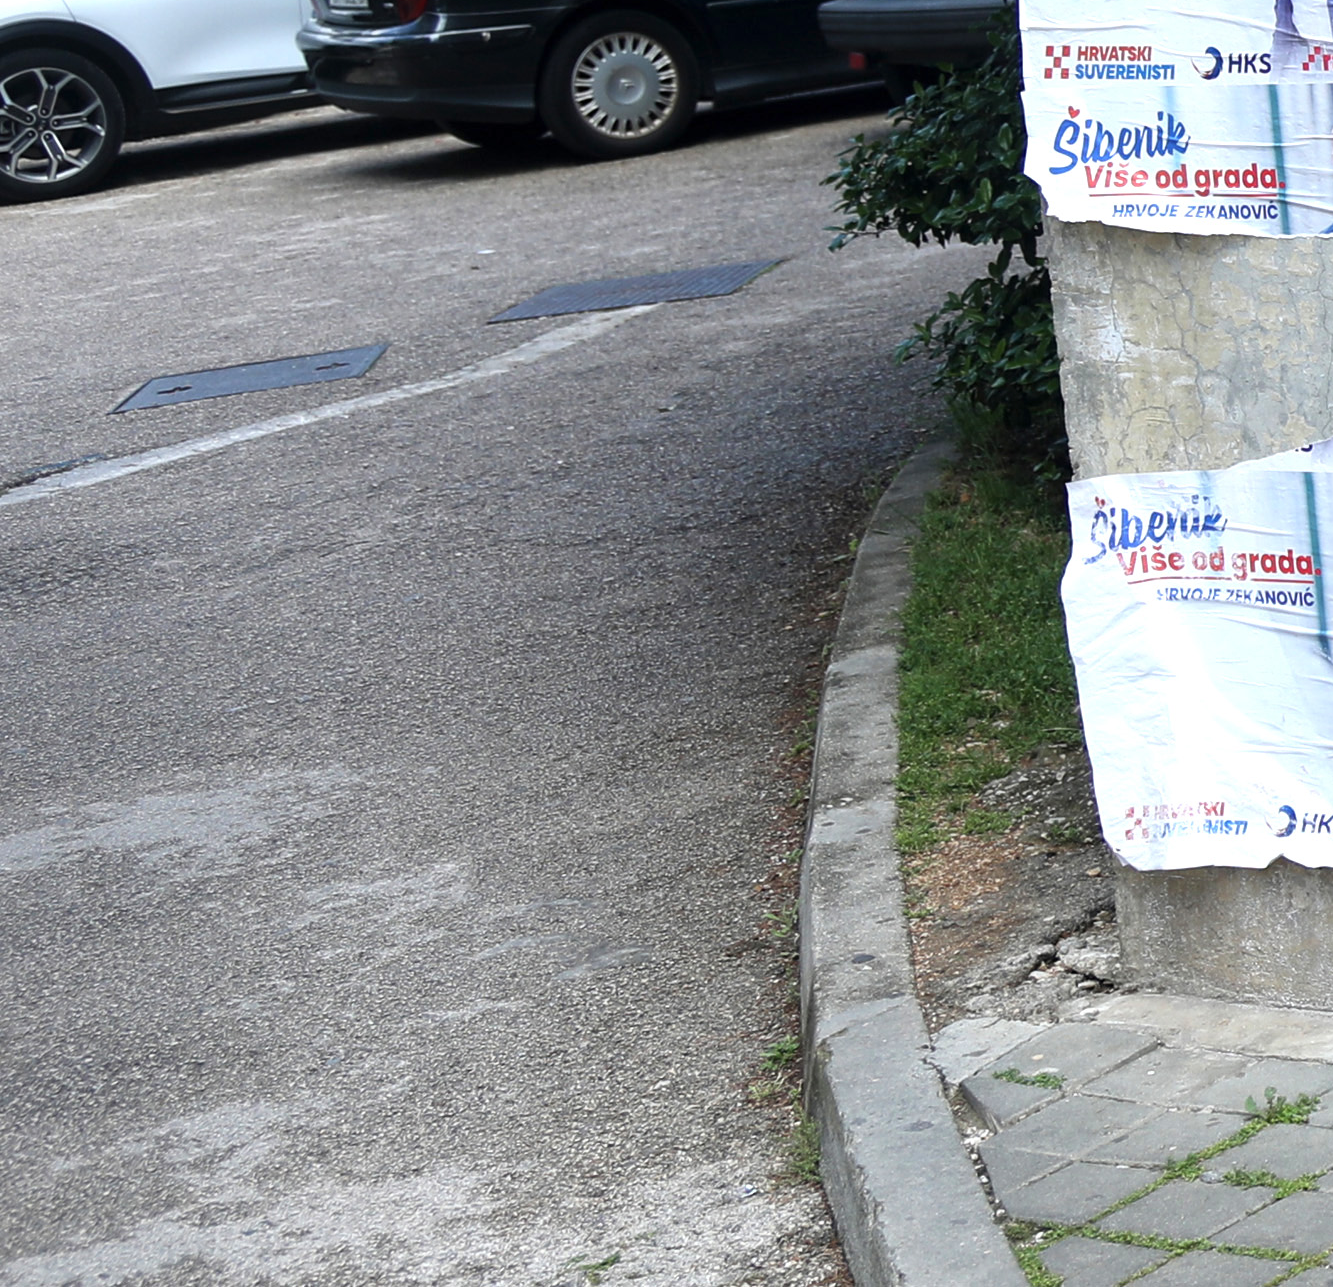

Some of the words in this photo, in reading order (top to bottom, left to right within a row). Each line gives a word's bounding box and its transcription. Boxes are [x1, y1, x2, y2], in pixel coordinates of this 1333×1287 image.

[1077, 46, 1151, 62] HRVATSKI
[1228, 53, 1271, 74] HKS
[1075, 64, 1175, 80] SUVERENISTI
[1049, 106, 1190, 175] Šibenik
[1084, 163, 1147, 189] Više
[1156, 164, 1187, 189] od
[1194, 163, 1285, 197] grada.
[1185, 201, 1278, 220] ZEKANOVIĆ
